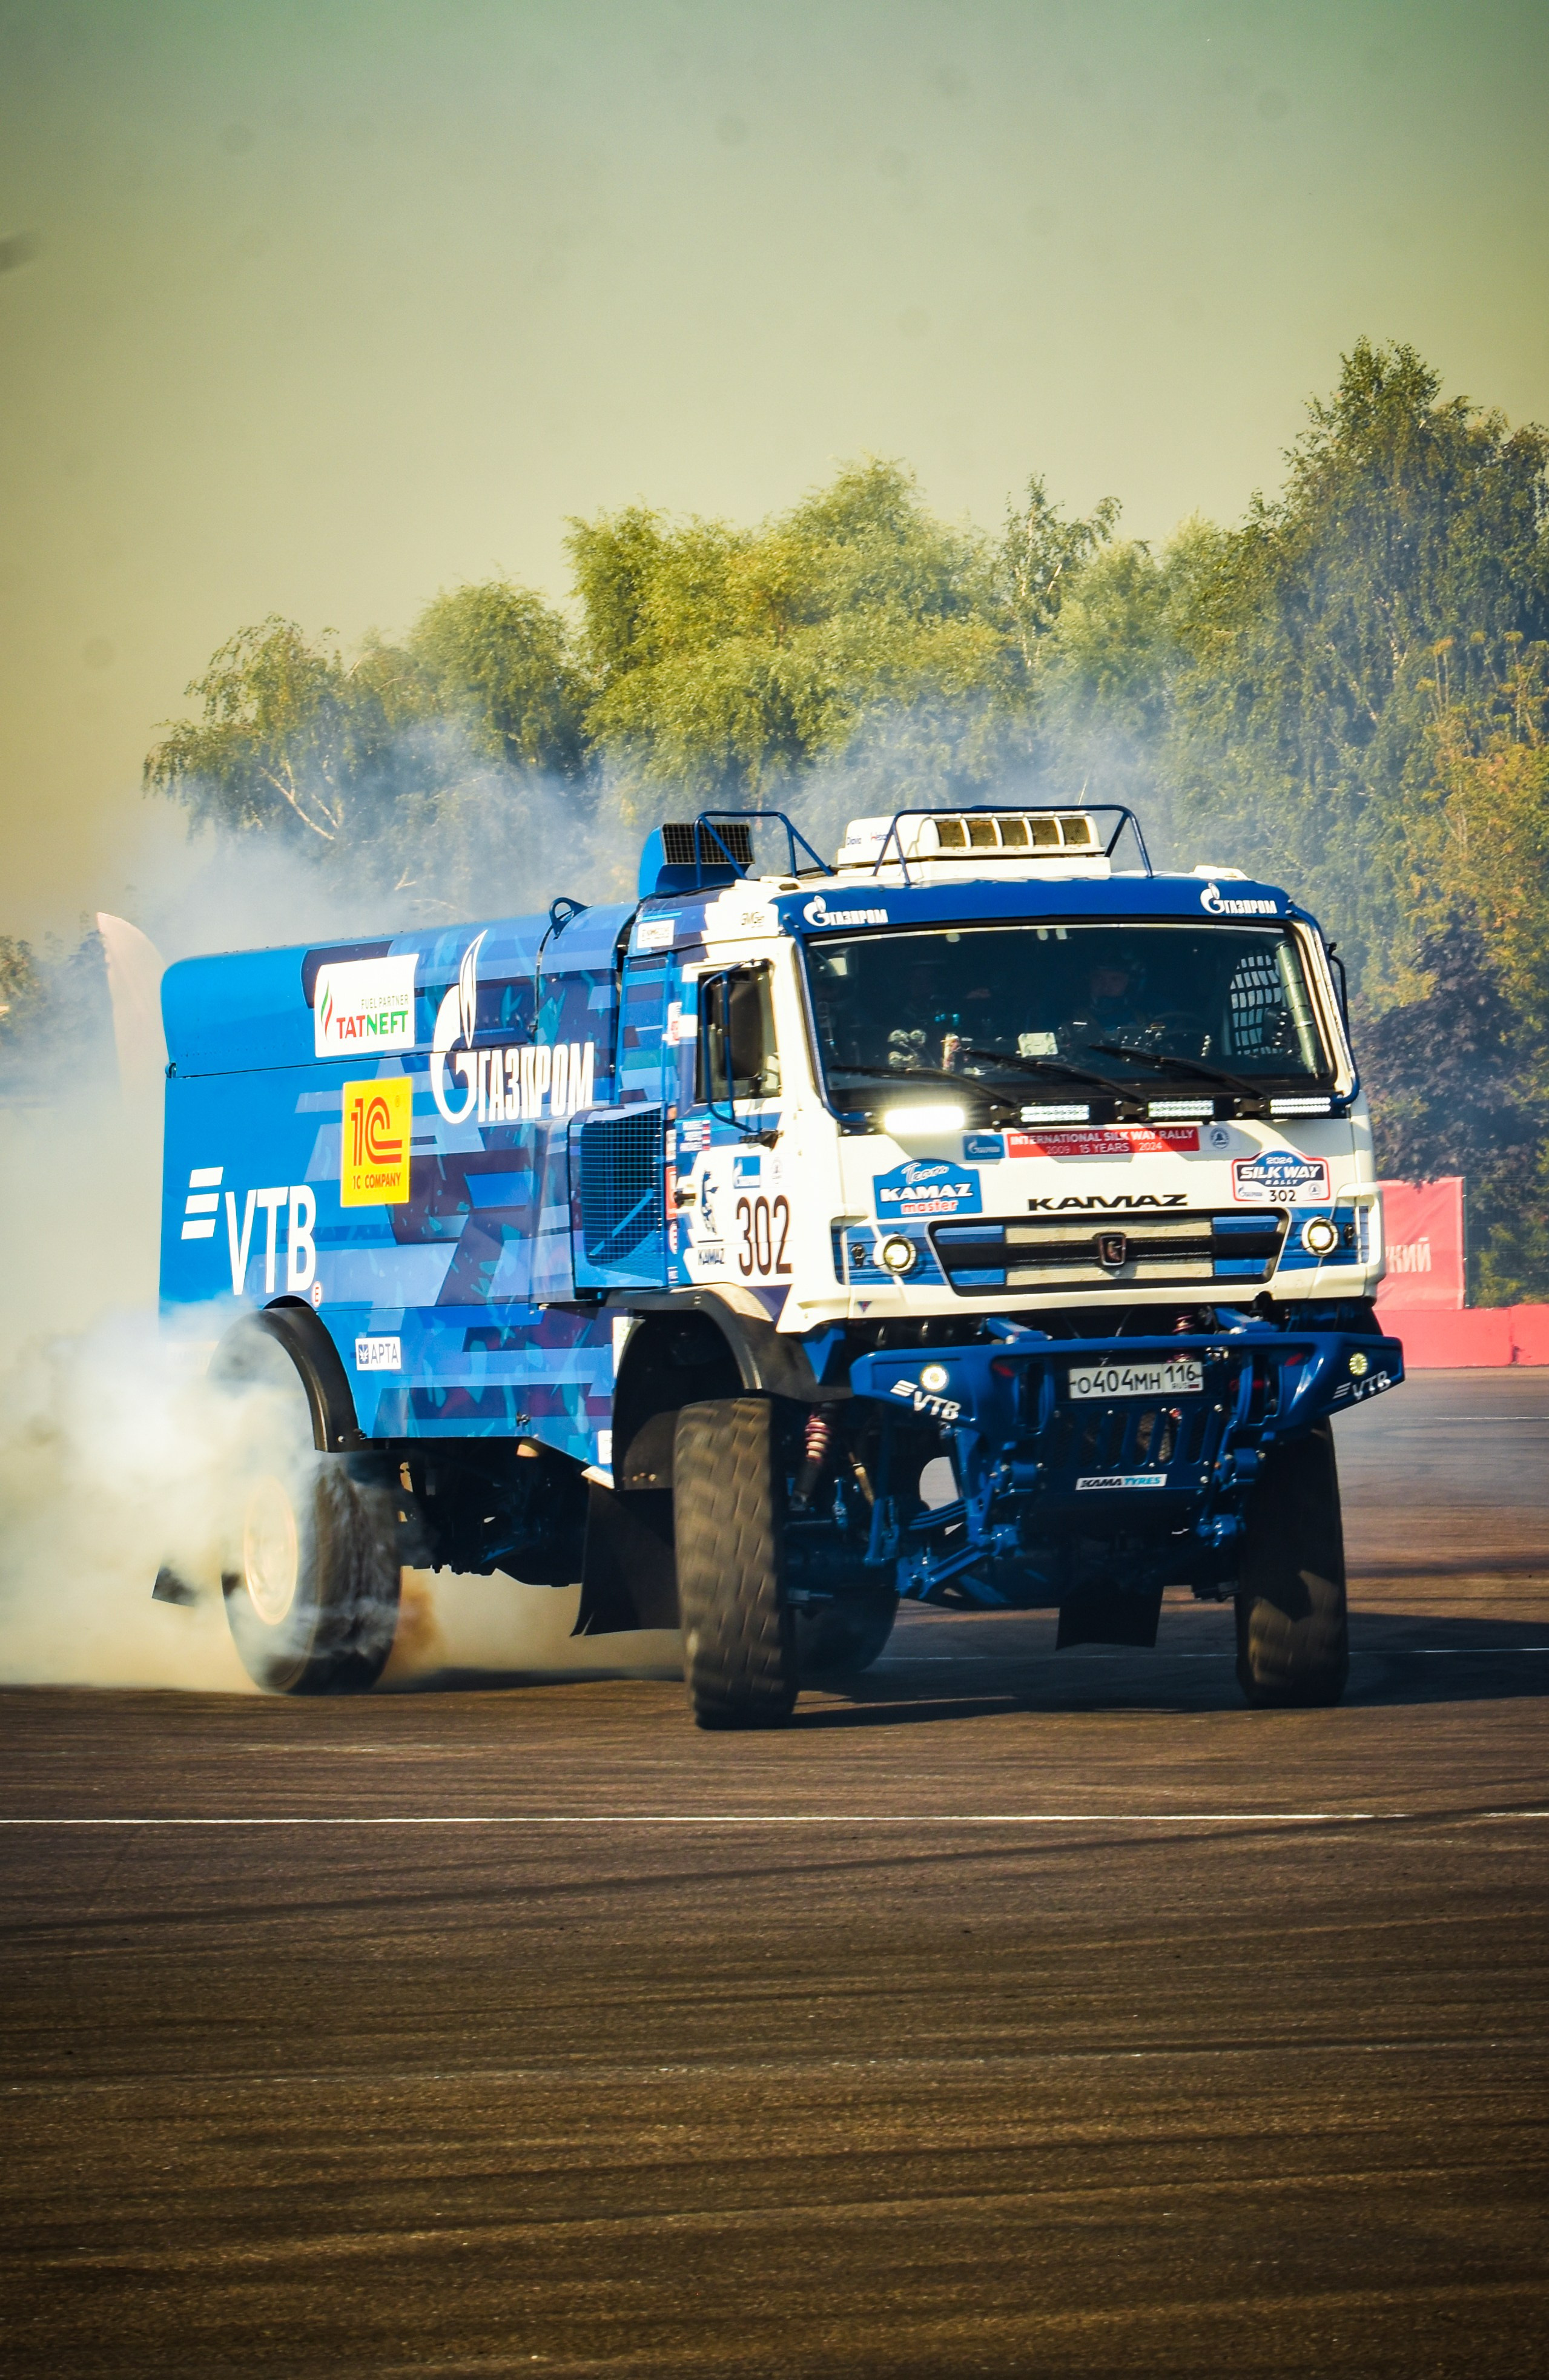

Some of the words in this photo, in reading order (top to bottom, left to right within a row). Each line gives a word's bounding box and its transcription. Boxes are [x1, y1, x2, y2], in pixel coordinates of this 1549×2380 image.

[1224, 900, 1278, 914] ГАЗПРОМ
[830, 909, 889, 926] ГАЗПРОМ
[361, 998, 377, 1010] FUEL
[378, 994, 409, 1008] PARTNER
[336, 1010, 409, 1039] TATNEFT
[477, 1042, 595, 1123] ГАЗПРОМ
[1009, 1131, 1102, 1146] INTERNATIONAL
[1104, 1131, 1129, 1142] SILK
[1131, 1129, 1157, 1141] WAY
[1159, 1129, 1194, 1140] RALLY
[1046, 1145, 1071, 1155] 2009
[1078, 1144, 1090, 1154] 15
[1092, 1143, 1130, 1153] YEARS
[1138, 1142, 1163, 1151] 2024
[364, 1172, 401, 1189] COMPANY
[900, 1162, 950, 1185] Team
[1239, 1166, 1281, 1180] SILK
[1283, 1166, 1322, 1179] WAY
[880, 1182, 974, 1203] KAMAZ
[1269, 1189, 1296, 1202] 302
[900, 1199, 959, 1215] master
[1029, 1194, 1187, 1211] KAMAZ
[225, 1185, 317, 1296] VTB
[735, 1194, 793, 1277] 302
[1165, 1364, 1197, 1382] 116
[1352, 1370, 1392, 1400] VTB
[913, 1390, 962, 1420] VTB
[1080, 1478, 1122, 1488] KAMA
[1123, 1476, 1161, 1486] TYRES
